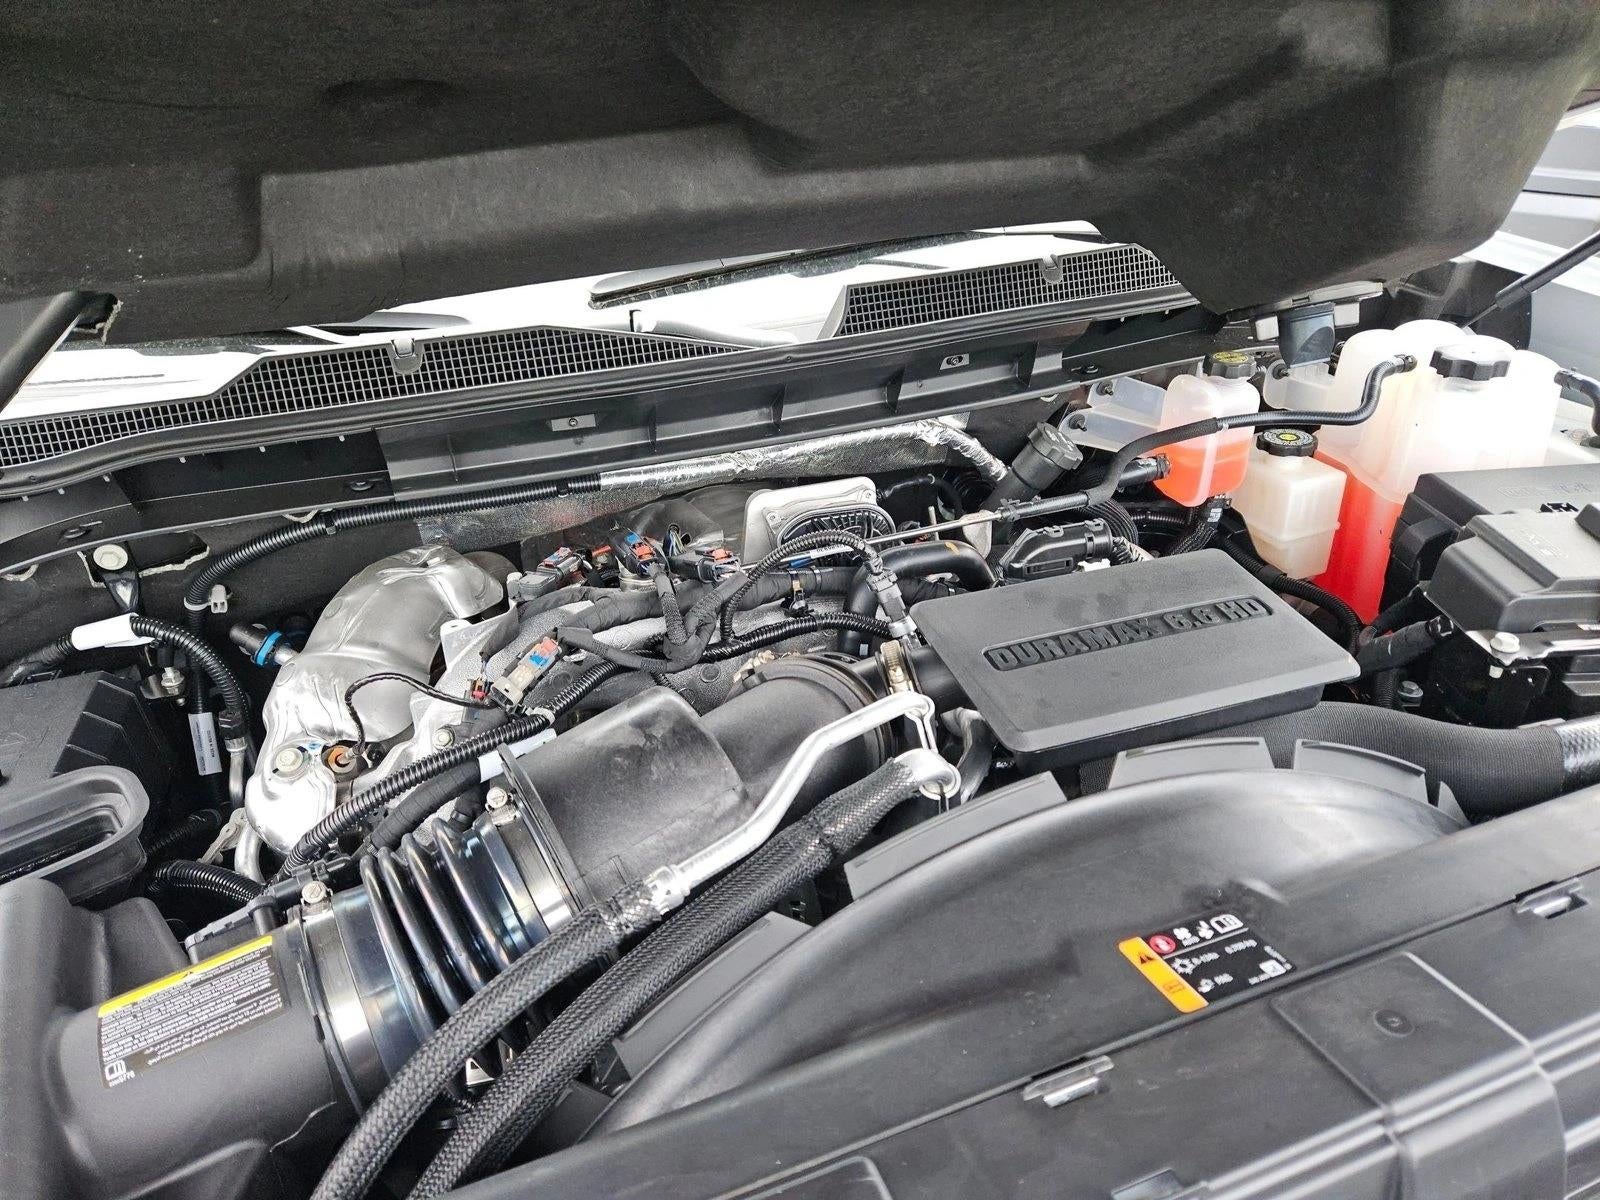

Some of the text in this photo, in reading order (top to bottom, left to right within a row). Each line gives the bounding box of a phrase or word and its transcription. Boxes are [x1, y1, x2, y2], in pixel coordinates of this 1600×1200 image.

[990, 598, 1268, 668] DURAMAX 6.6 HD
